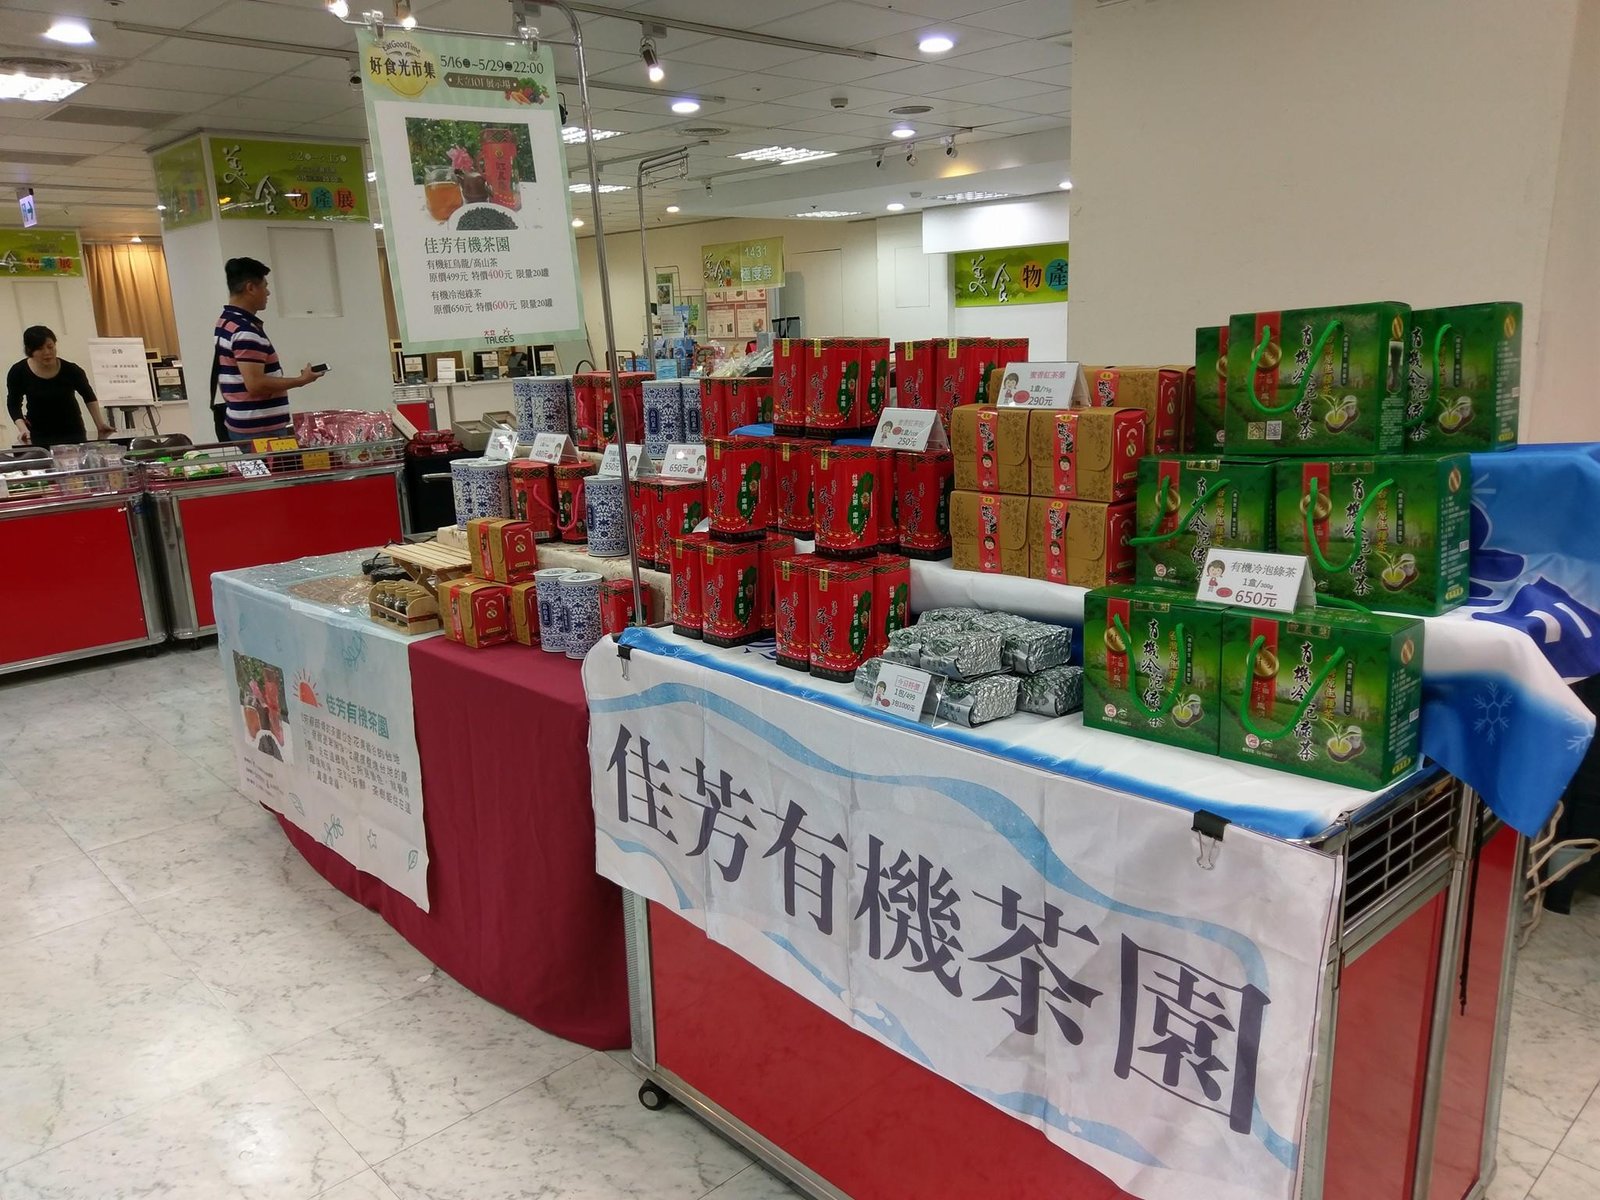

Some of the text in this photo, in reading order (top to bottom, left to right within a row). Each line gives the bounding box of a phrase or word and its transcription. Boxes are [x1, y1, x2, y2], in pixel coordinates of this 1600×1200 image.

[370, 56, 436, 79] 好食光市集
[424, 236, 511, 255] 佳芳有機茶園
[426, 257, 499, 270] 有機紅烏龍/高山茶
[429, 268, 550, 283] 原價499元 特價400元 限量20罐
[431, 289, 483, 301] 有機冷泡綠茶
[433, 298, 553, 315] 原價650元 特價600元 限量20罐
[1028, 396, 1053, 406] 290元
[669, 463, 688, 473] 650元
[1231, 561, 1297, 578] 有機冷泡綠茶
[1235, 590, 1278, 607] 650元
[326, 694, 390, 740] 佳芳有機茶園
[607, 724, 1271, 1134] 佳芳有機茶園
